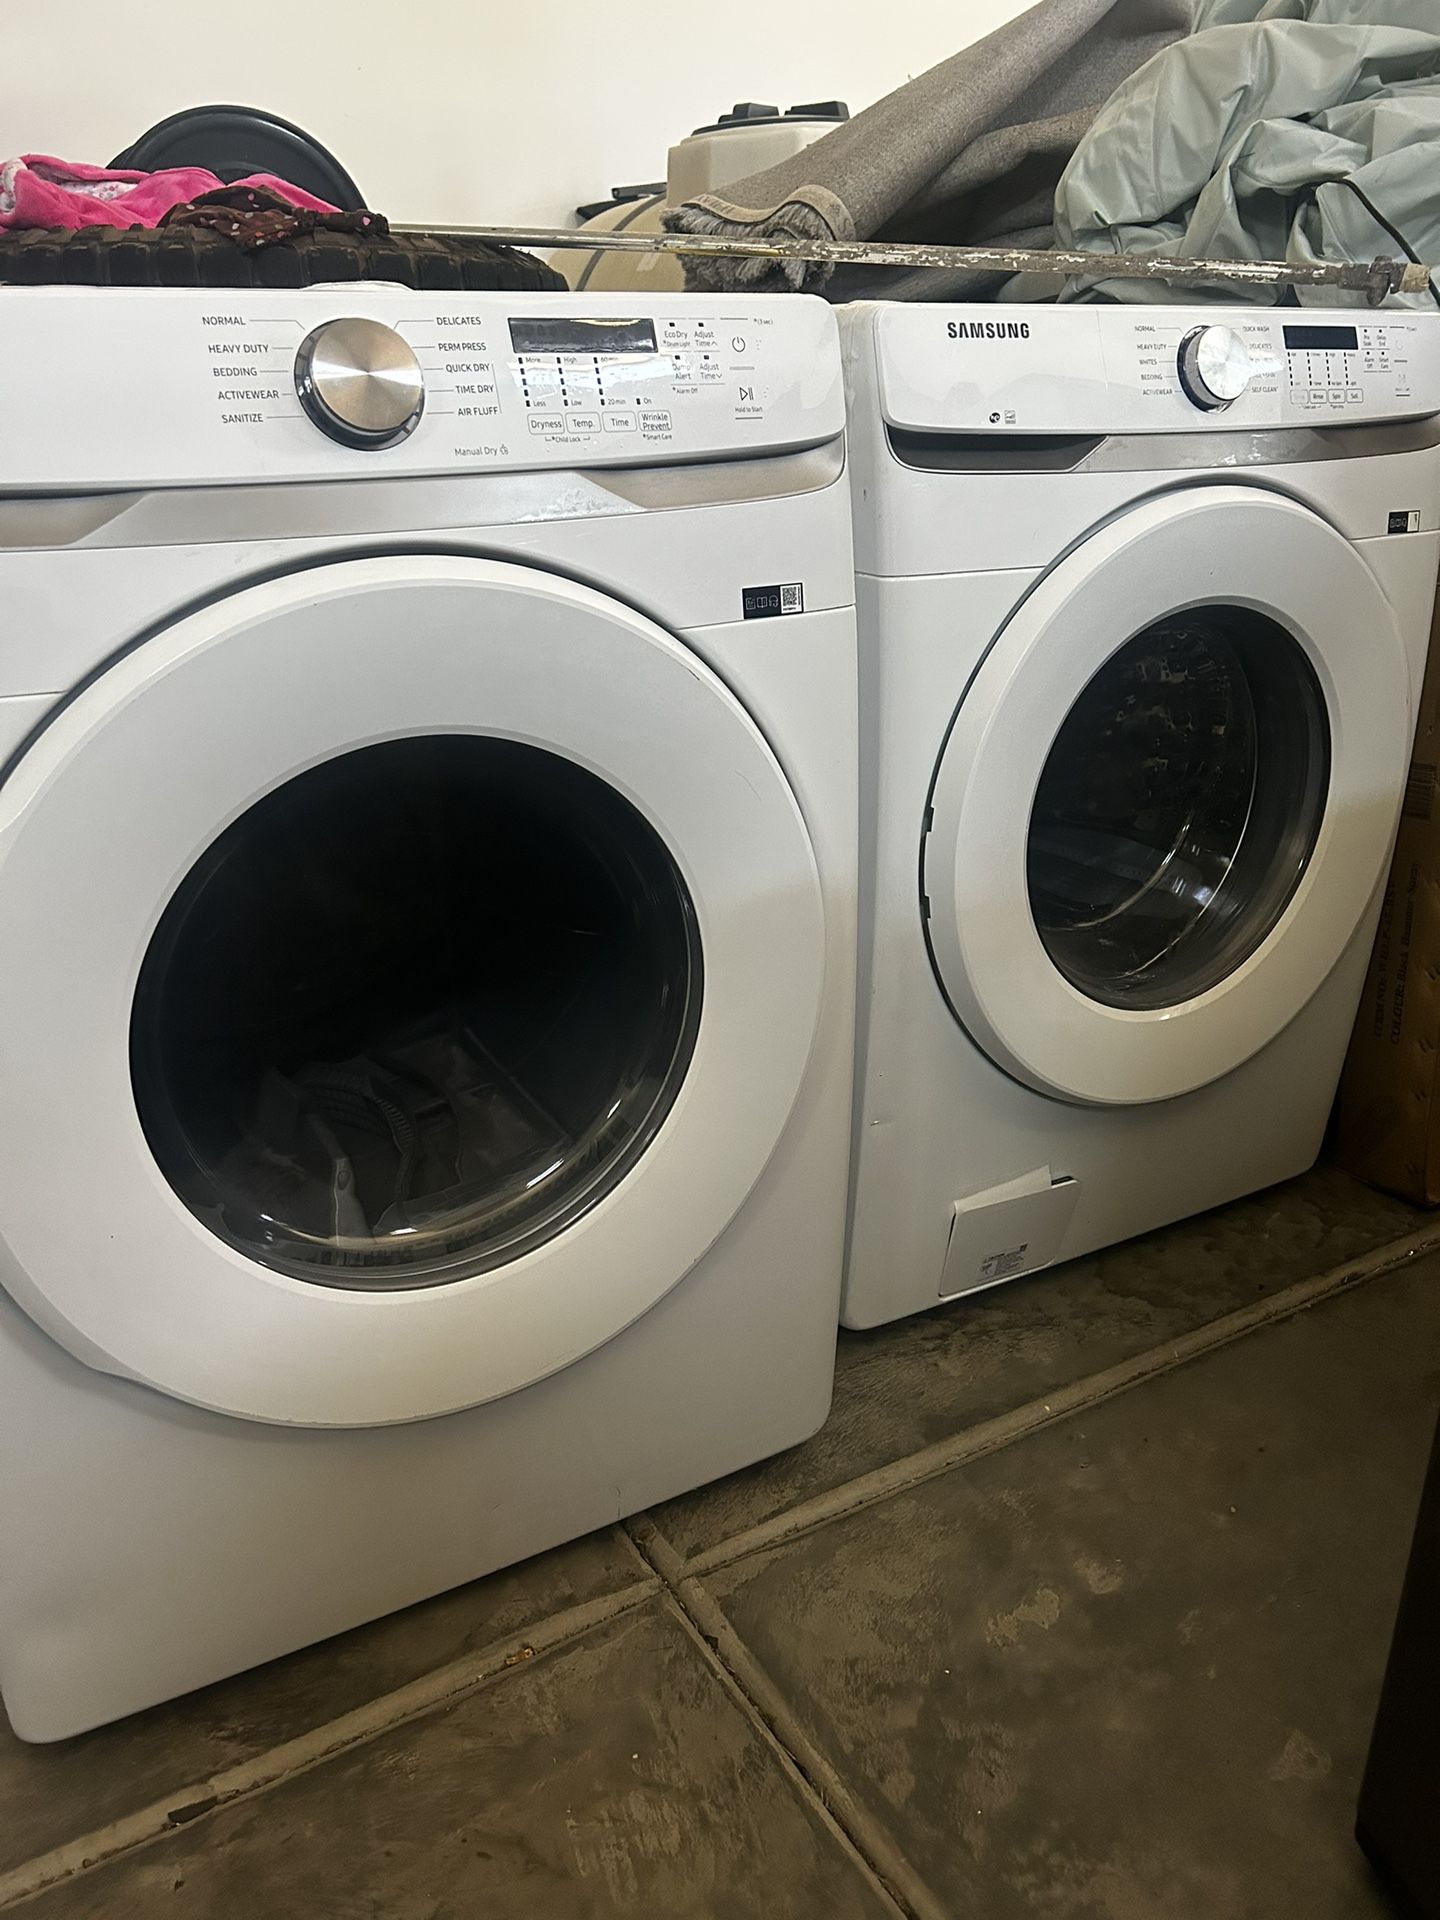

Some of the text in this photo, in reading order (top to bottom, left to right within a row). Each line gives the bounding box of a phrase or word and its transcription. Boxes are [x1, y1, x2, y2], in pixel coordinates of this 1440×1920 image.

[202, 317, 246, 325] NORMAL
[436, 317, 482, 325] DELICATES
[694, 331, 714, 339] Adjust
[947, 322, 1030, 339] SAMSUNG
[208, 344, 269, 353] HEAVY DUTY
[438, 343, 487, 351] PERM PRESS
[213, 367, 257, 376] BEDDING
[445, 364, 490, 373] QUICK DRY
[700, 363, 719, 372] Adjust
[675, 372, 691, 380] Alert
[455, 385, 494, 394] TIME DRY
[218, 390, 279, 400] ACTIVEWEAR
[458, 407, 499, 416] AIR FLUFF
[222, 414, 263, 423] SANITIZE
[642, 413, 668, 421] Wrinkle
[531, 420, 562, 430] Dryness
[572, 418, 595, 428] Temp.
[611, 417, 630, 427] Time
[643, 422, 669, 431] Prevent
[454, 447, 498, 457] Manual Dry
